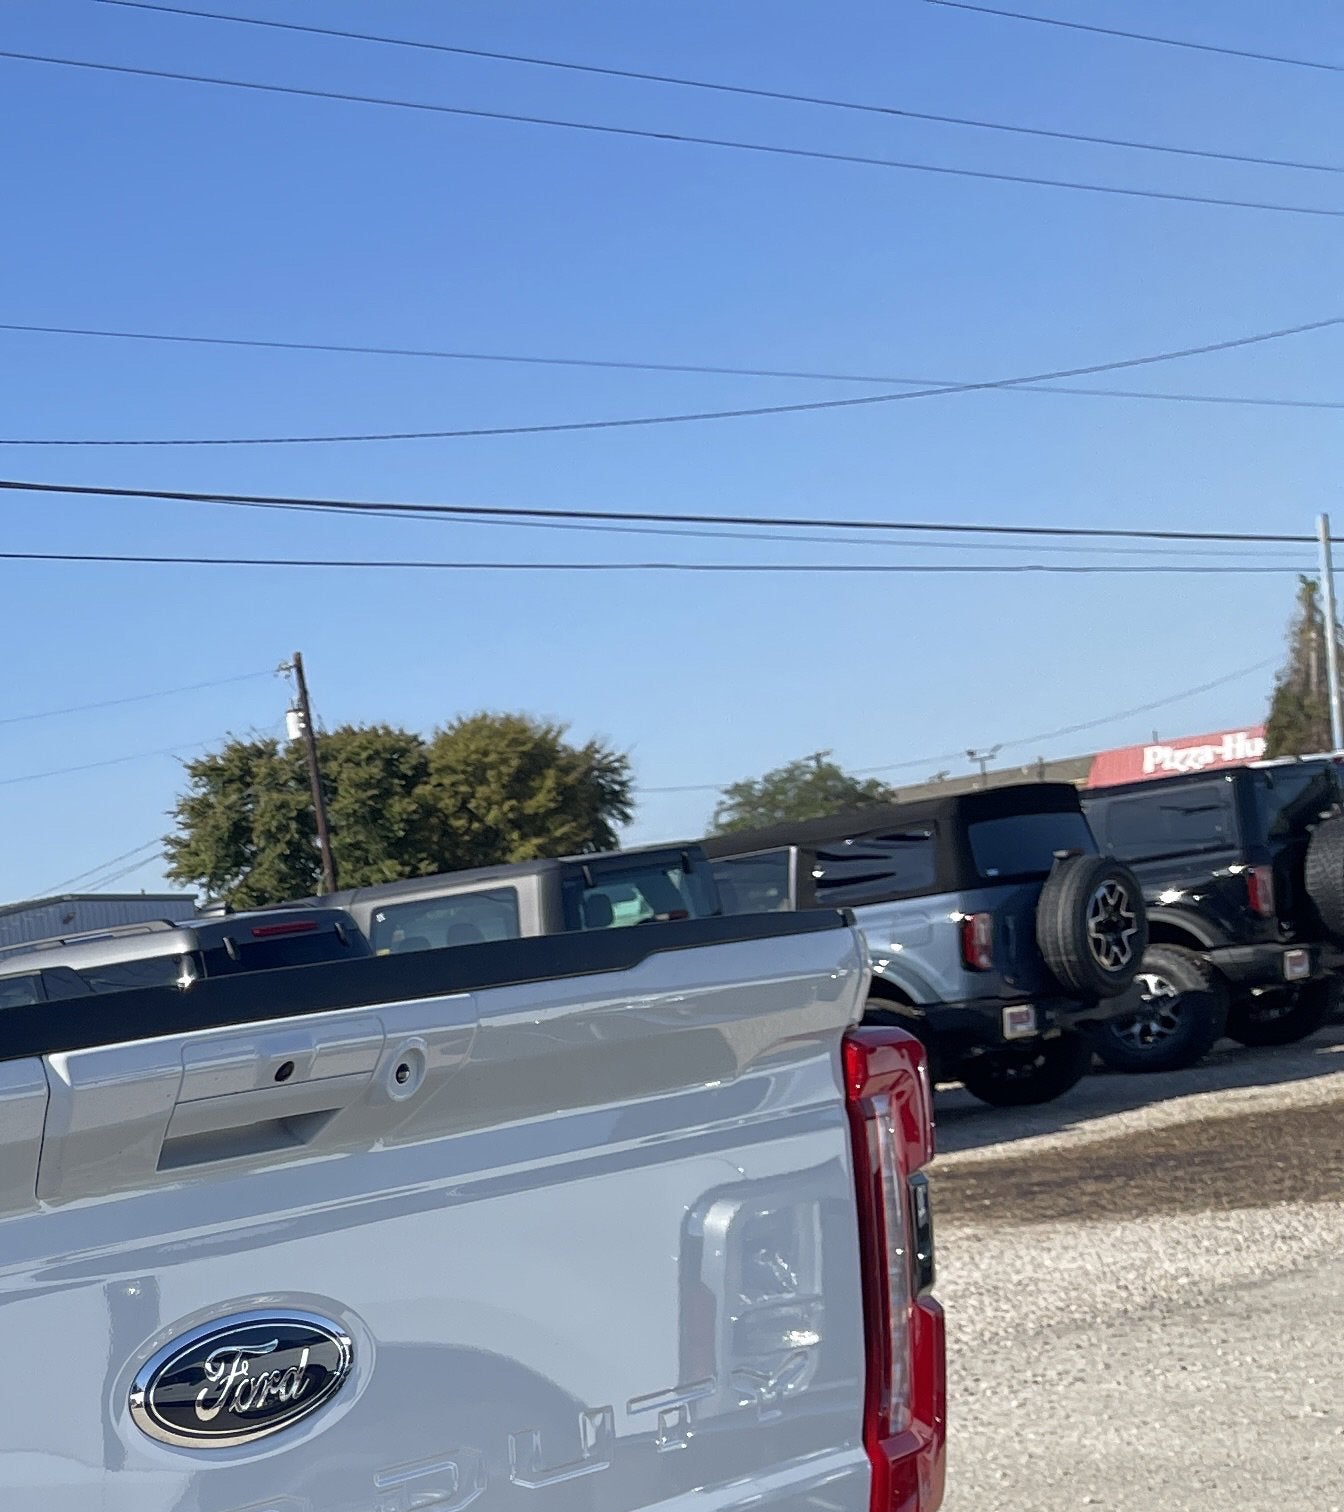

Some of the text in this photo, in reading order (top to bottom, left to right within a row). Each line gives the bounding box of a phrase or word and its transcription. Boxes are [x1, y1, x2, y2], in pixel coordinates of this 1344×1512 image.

[1143, 731, 1267, 774] Pizza Hu
[195, 1338, 311, 1422] Ford
